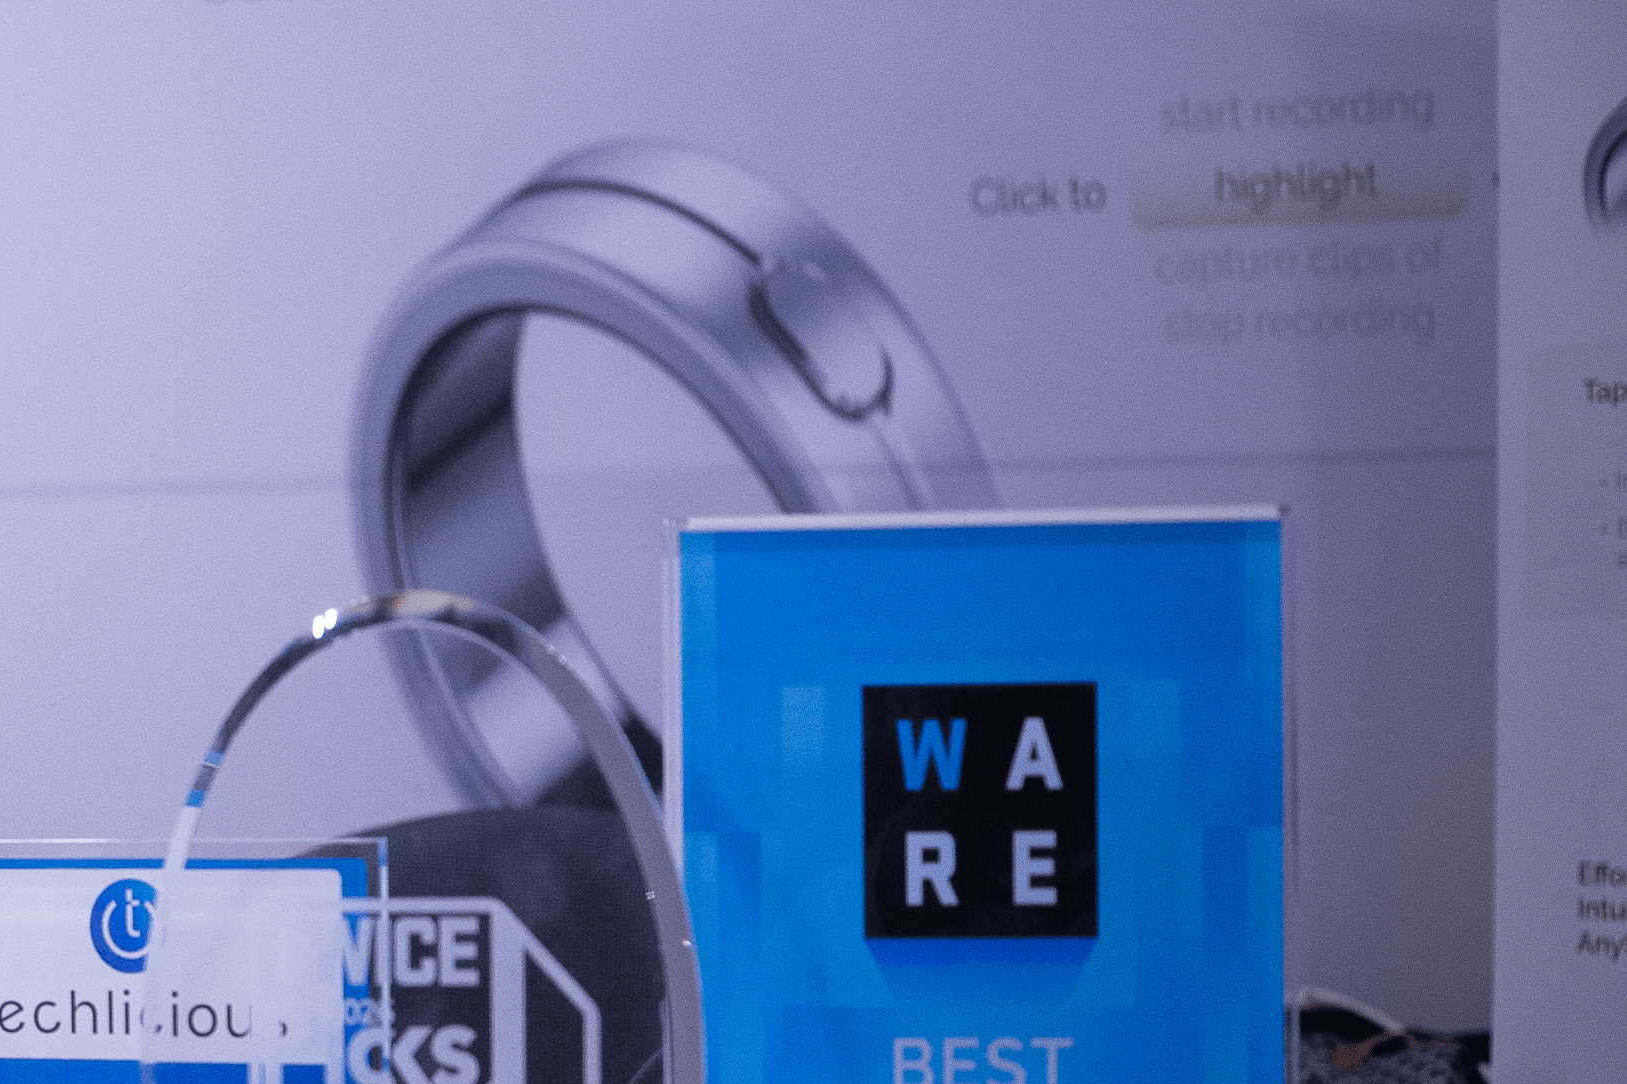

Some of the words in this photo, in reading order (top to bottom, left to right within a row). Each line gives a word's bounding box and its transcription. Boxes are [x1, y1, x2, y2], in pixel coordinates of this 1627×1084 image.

[1160, 94, 1244, 133] start
[1253, 87, 1435, 132] recording
[971, 175, 1059, 217] Click
[1068, 178, 1107, 214] to
[1214, 162, 1381, 215] highlight
[1153, 247, 1300, 287] capture
[1307, 241, 1392, 282] clips
[1403, 235, 1443, 276] of
[1165, 308, 1245, 345] stop
[1254, 303, 1436, 346] recording
[1577, 860, 1627, 889] Effo
